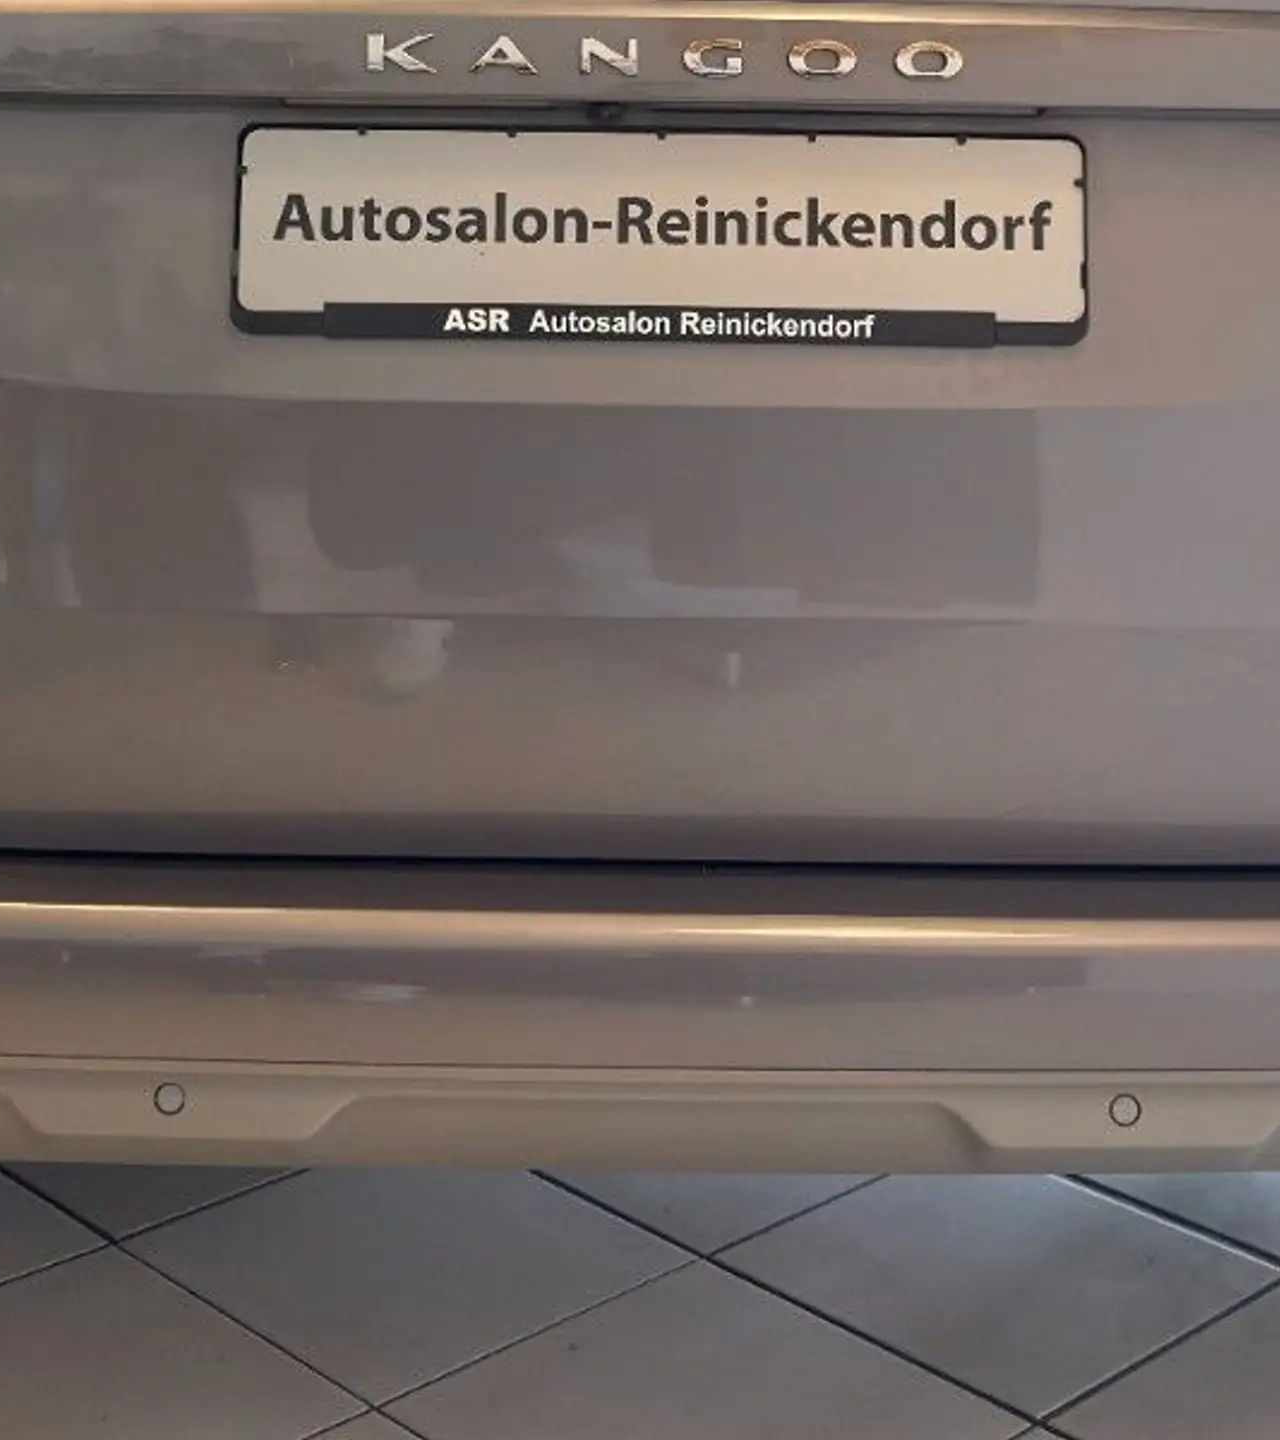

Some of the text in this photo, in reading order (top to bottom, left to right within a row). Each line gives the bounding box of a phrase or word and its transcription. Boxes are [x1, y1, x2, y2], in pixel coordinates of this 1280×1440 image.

[366, 32, 964, 79] KANGOO
[273, 193, 1053, 251] Autosalon-Reinickendorf
[444, 308, 875, 339] ASR Autosalon Reinickendorf
